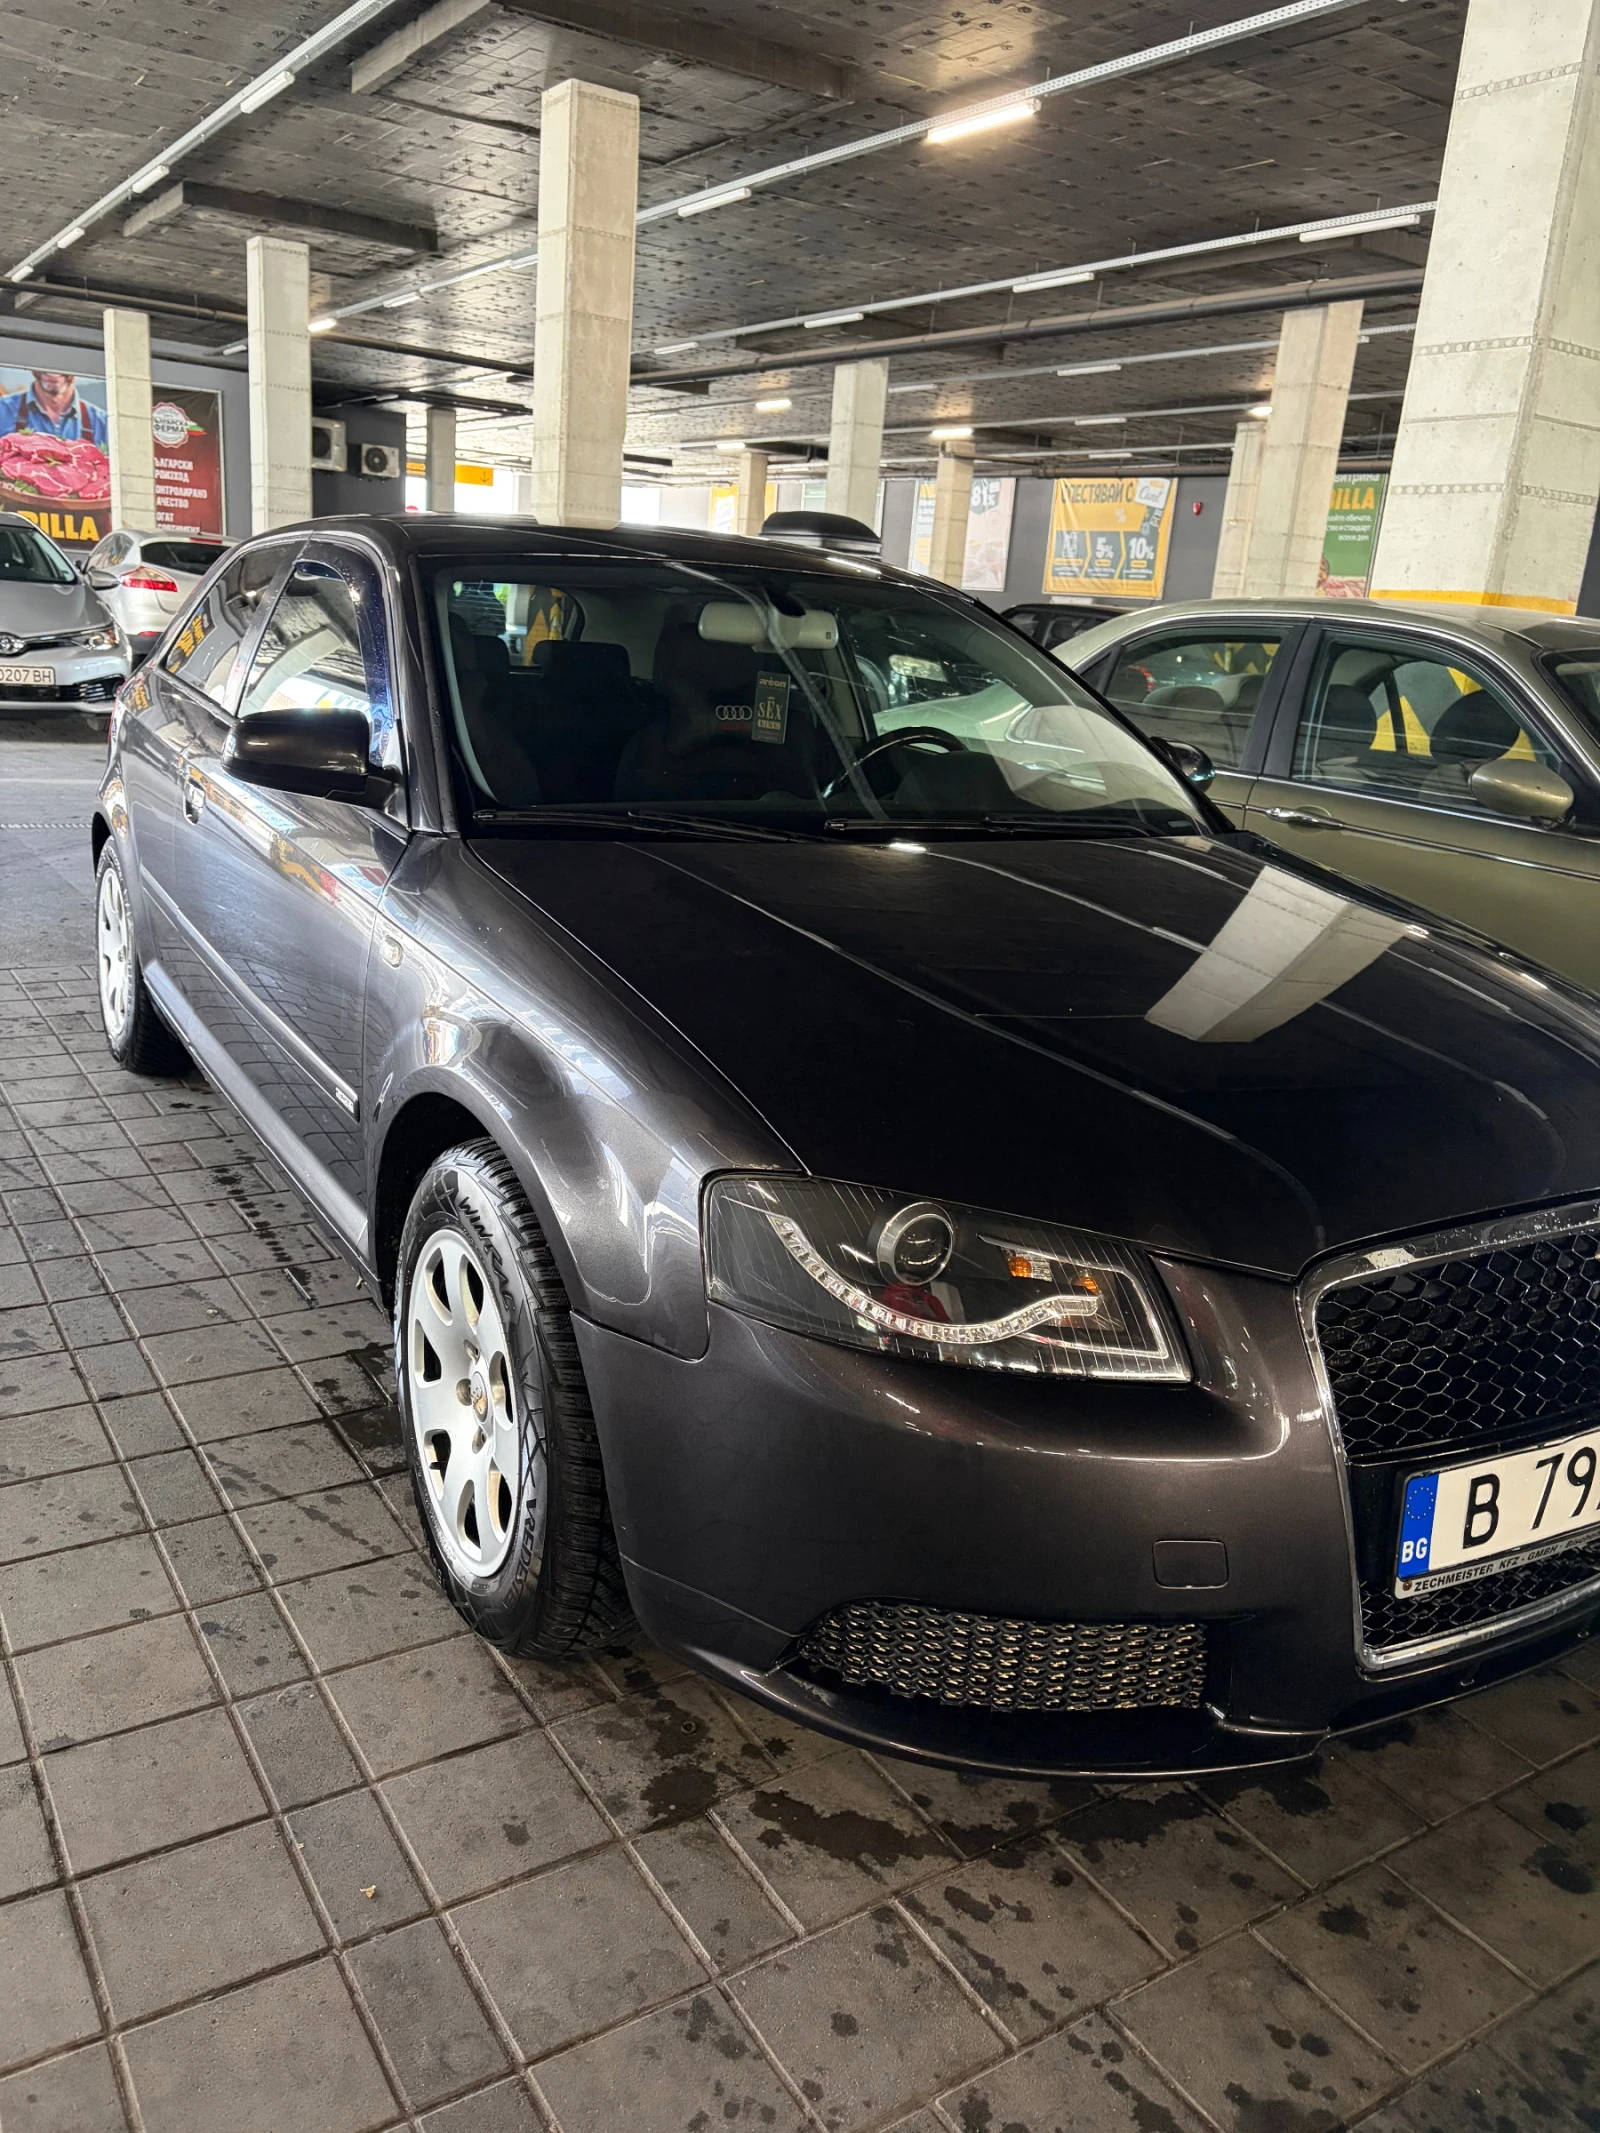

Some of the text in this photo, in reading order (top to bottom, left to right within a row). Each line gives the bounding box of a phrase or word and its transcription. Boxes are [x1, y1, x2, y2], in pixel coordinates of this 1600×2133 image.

[154, 424, 184, 432] ФЕРМА
[154, 457, 193, 470] ЪЛГАРСКИ
[155, 469, 190, 483] РОИЗХОД
[155, 484, 207, 499] ОНТРОЛИРАНО
[157, 496, 189, 509] АЧЕСТВО
[156, 512, 174, 522] ОГАТ
[1095, 537, 1114, 559] 5%
[1128, 537, 1155, 560] 10%
[33, 670, 52, 683] BH
[1462, 1446, 1600, 1549] B 79
[1400, 1537, 1429, 1563] BG
[1413, 1563, 1495, 1593] ZECHMEISTER
[1499, 1556, 1521, 1570] KFZ
[1527, 1545, 1559, 1561] GMBH
